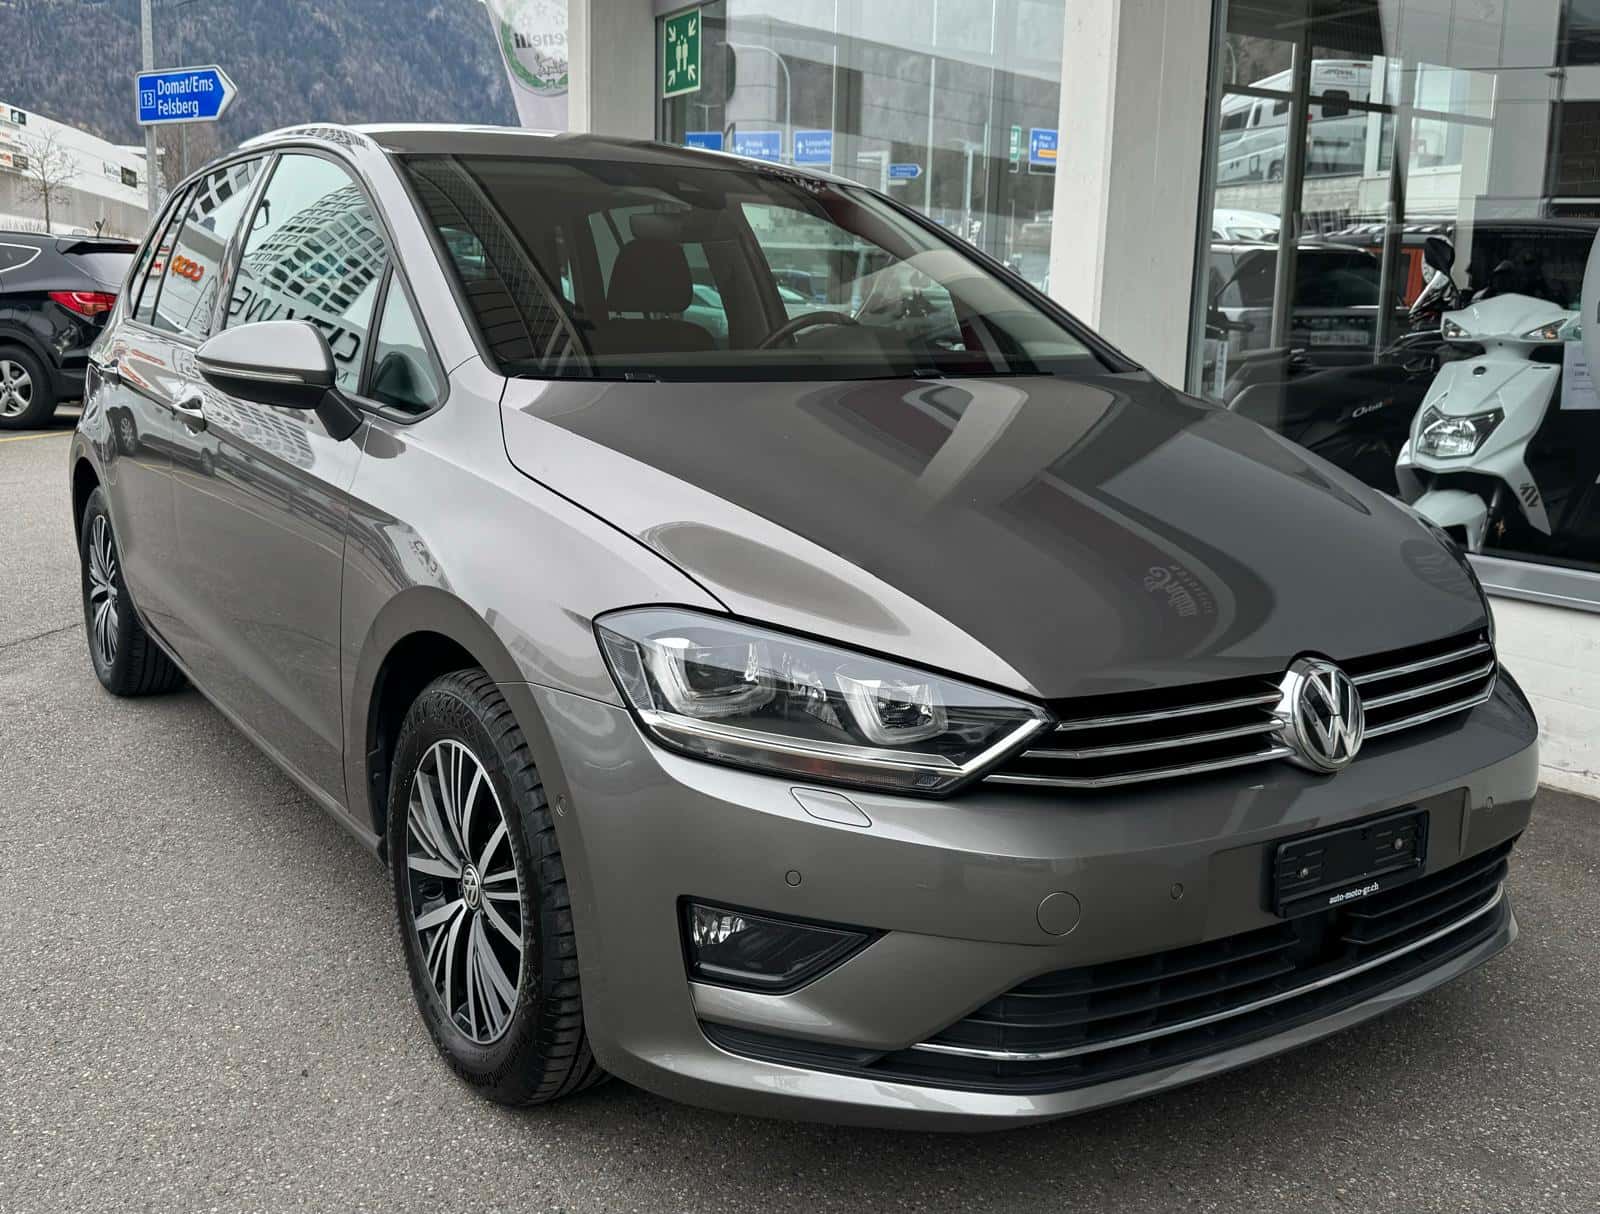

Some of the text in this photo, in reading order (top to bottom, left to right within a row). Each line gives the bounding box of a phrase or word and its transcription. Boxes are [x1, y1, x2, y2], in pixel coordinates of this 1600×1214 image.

[157, 76, 214, 95] Domat/Ems
[143, 92, 153, 106] 13
[158, 97, 199, 117] Felsberg
